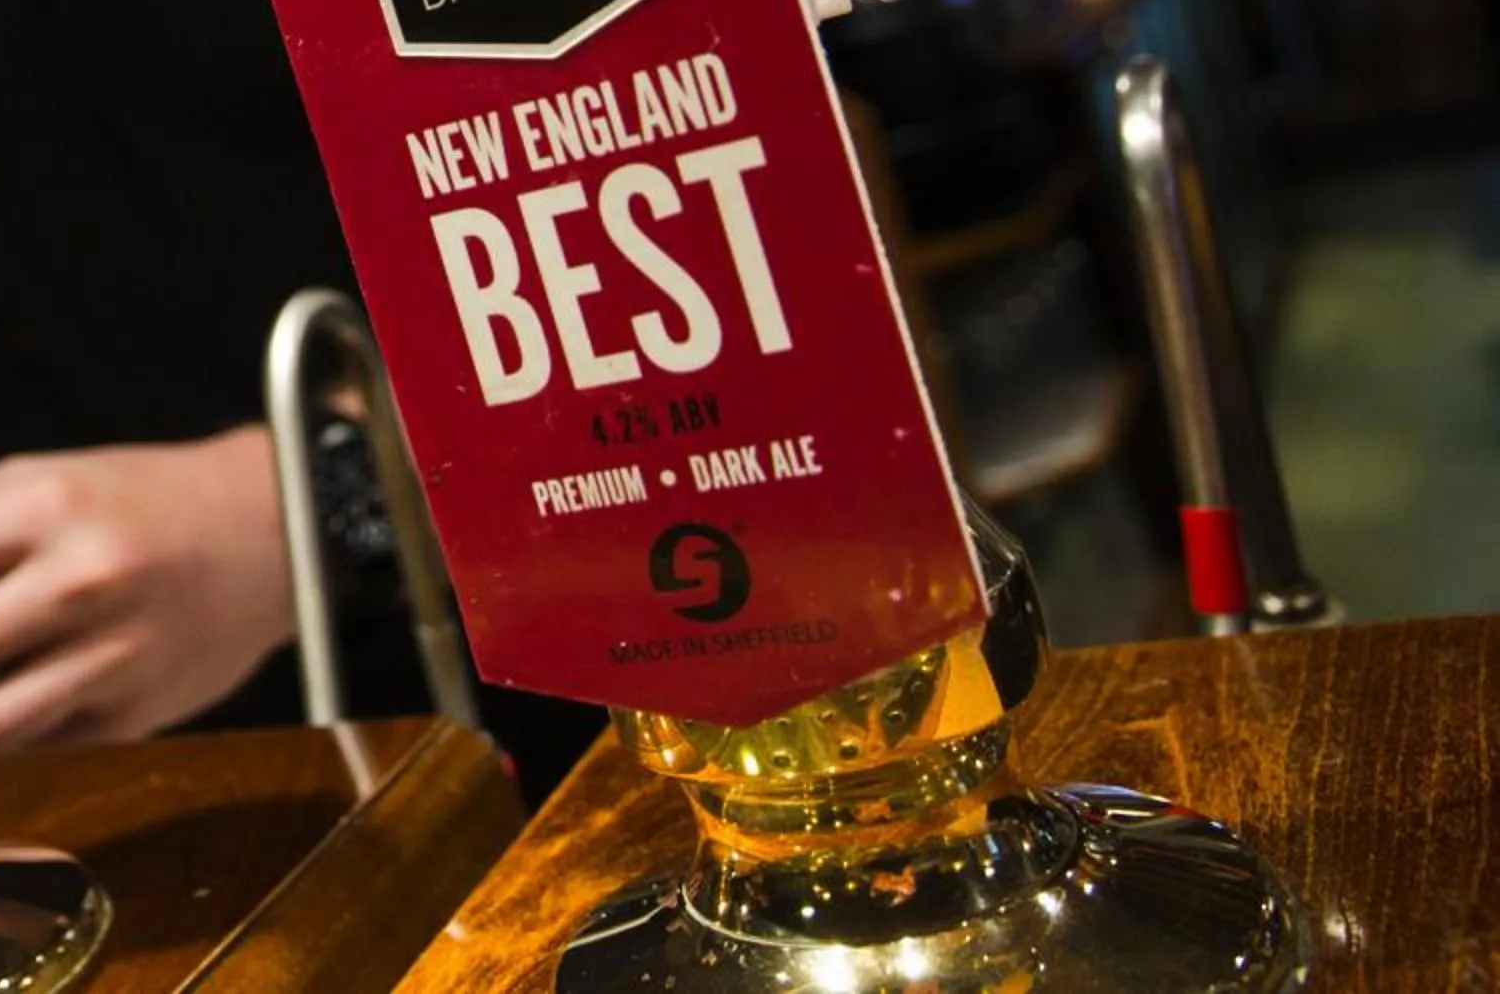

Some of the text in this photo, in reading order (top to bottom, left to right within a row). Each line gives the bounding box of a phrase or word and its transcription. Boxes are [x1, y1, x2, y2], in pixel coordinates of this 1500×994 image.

[406, 52, 738, 200] NEW ENGLAND
[430, 135, 793, 408] BEST
[590, 394, 722, 446] 4.2% ABV
[532, 435, 822, 518] PREMIUM DARK ALE
[609, 620, 838, 666] MADE IN SHEFFIELD
